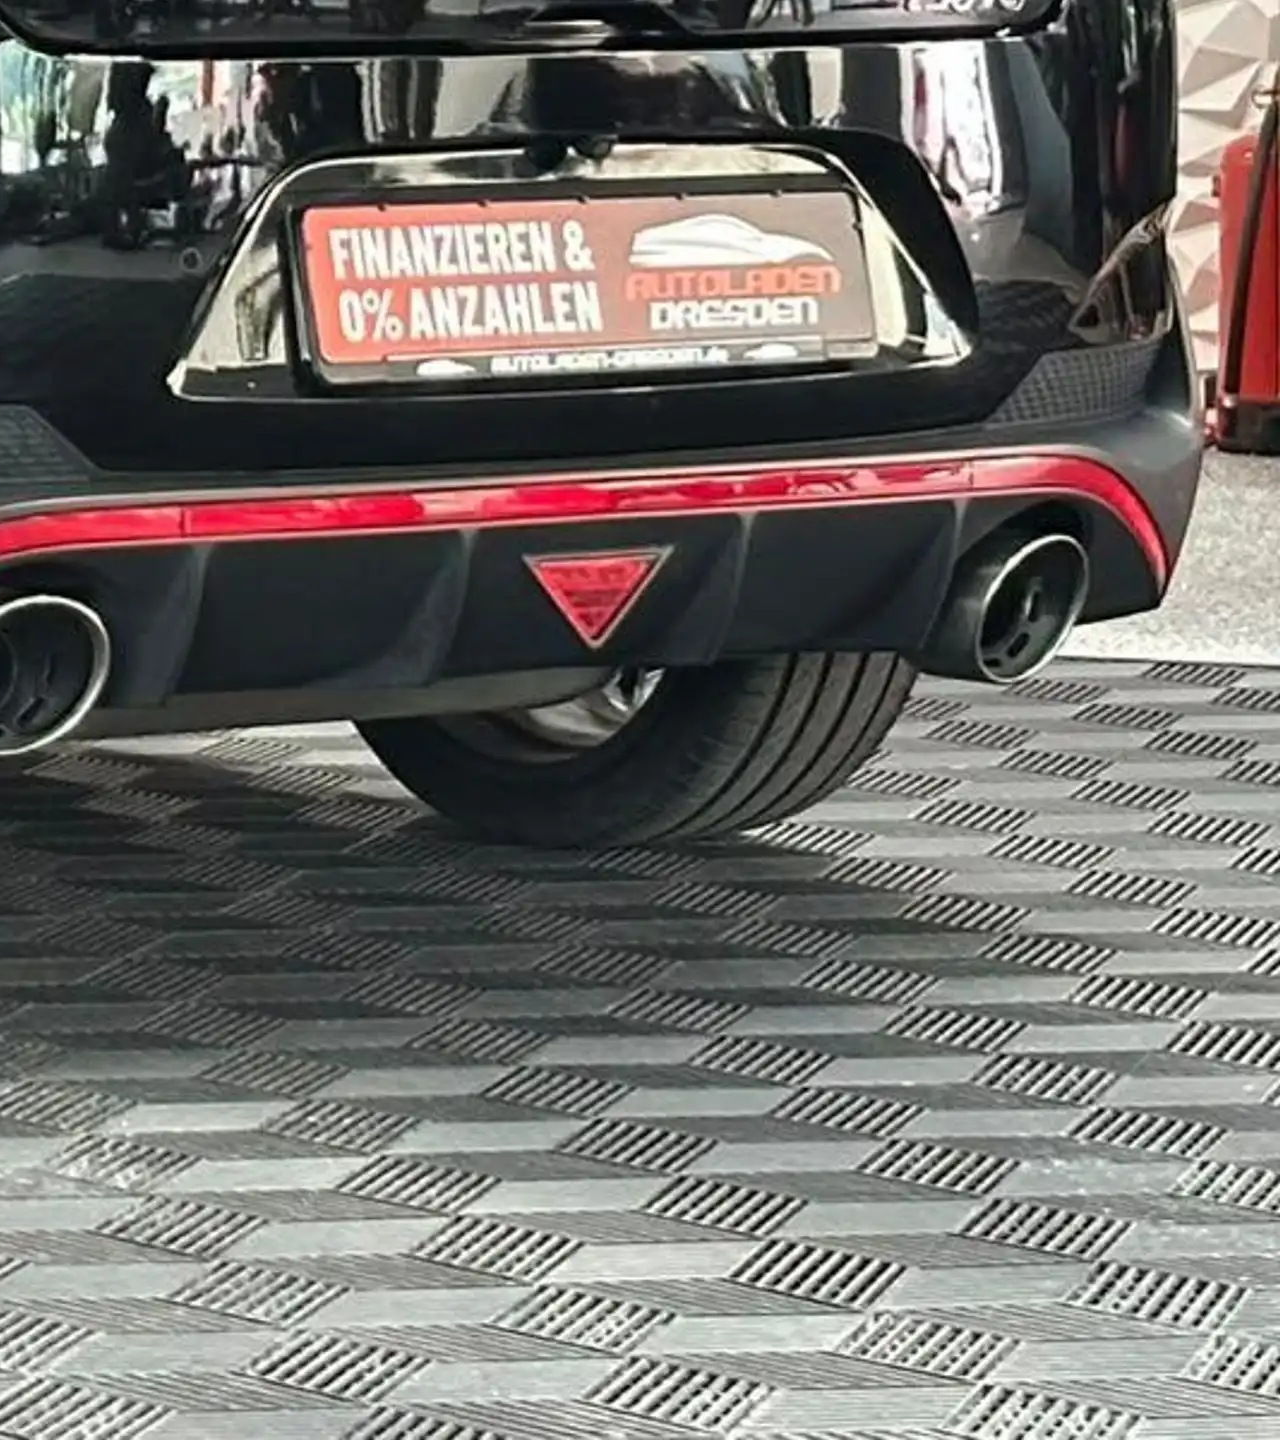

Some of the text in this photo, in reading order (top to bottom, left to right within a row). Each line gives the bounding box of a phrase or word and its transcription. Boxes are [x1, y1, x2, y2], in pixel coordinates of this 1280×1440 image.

[329, 220, 594, 278] FINANZIEREN &
[626, 268, 841, 301] AUTOLADEN
[339, 281, 602, 342] 0% ANZAHLEN
[650, 298, 819, 330] DRESDEN
